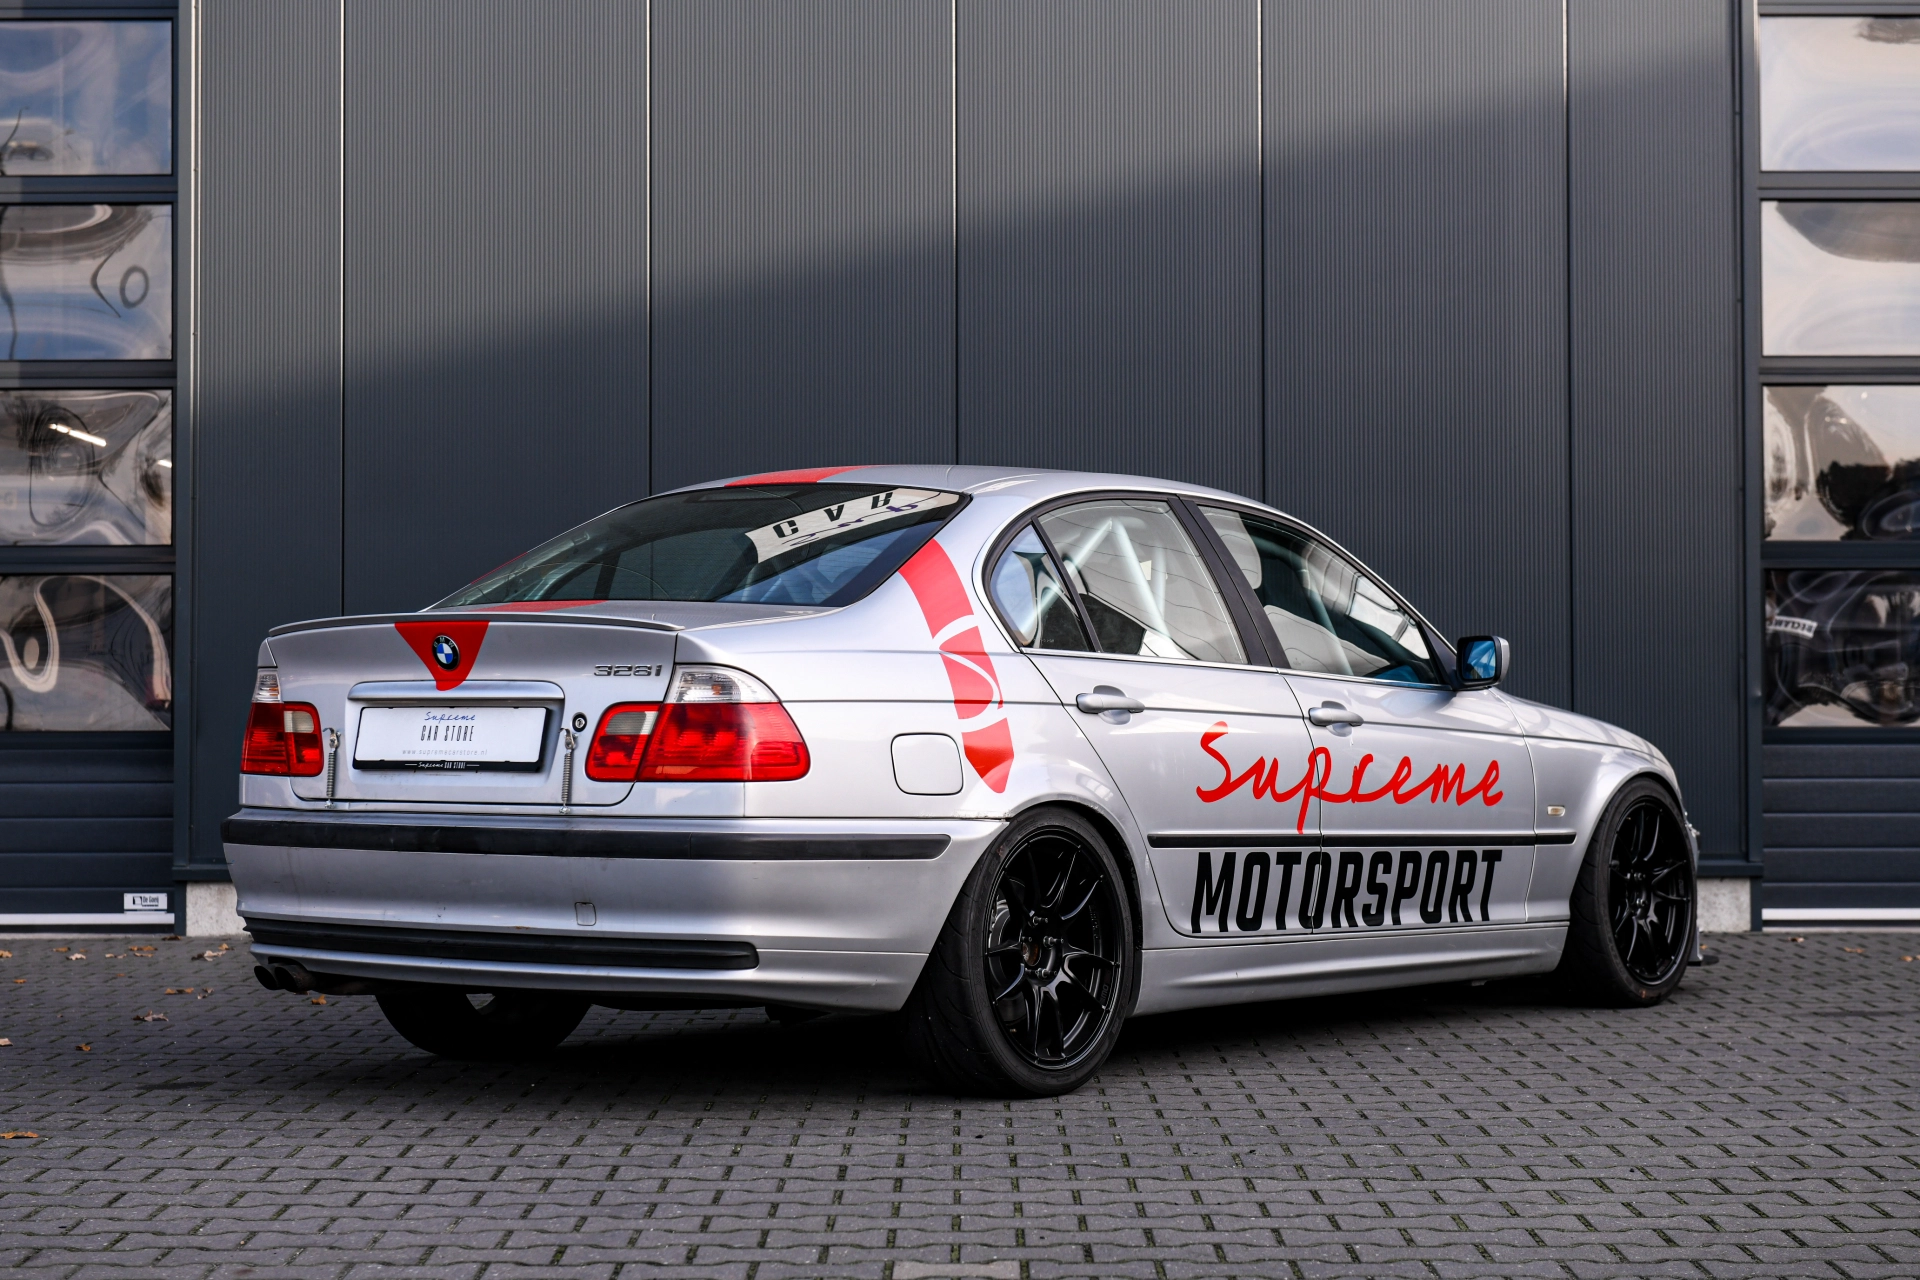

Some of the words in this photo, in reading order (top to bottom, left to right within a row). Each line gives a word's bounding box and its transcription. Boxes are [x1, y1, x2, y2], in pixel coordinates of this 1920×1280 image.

[433, 636, 455, 648] BMW
[593, 664, 662, 677] 328i
[424, 711, 475, 724] Supreme
[420, 725, 439, 741] CAR
[444, 725, 474, 741] STORE
[402, 748, 488, 756] www.supremecarstore.nl
[1196, 720, 1503, 835] Supreme
[1191, 849, 1503, 934] MOTORSPORT
